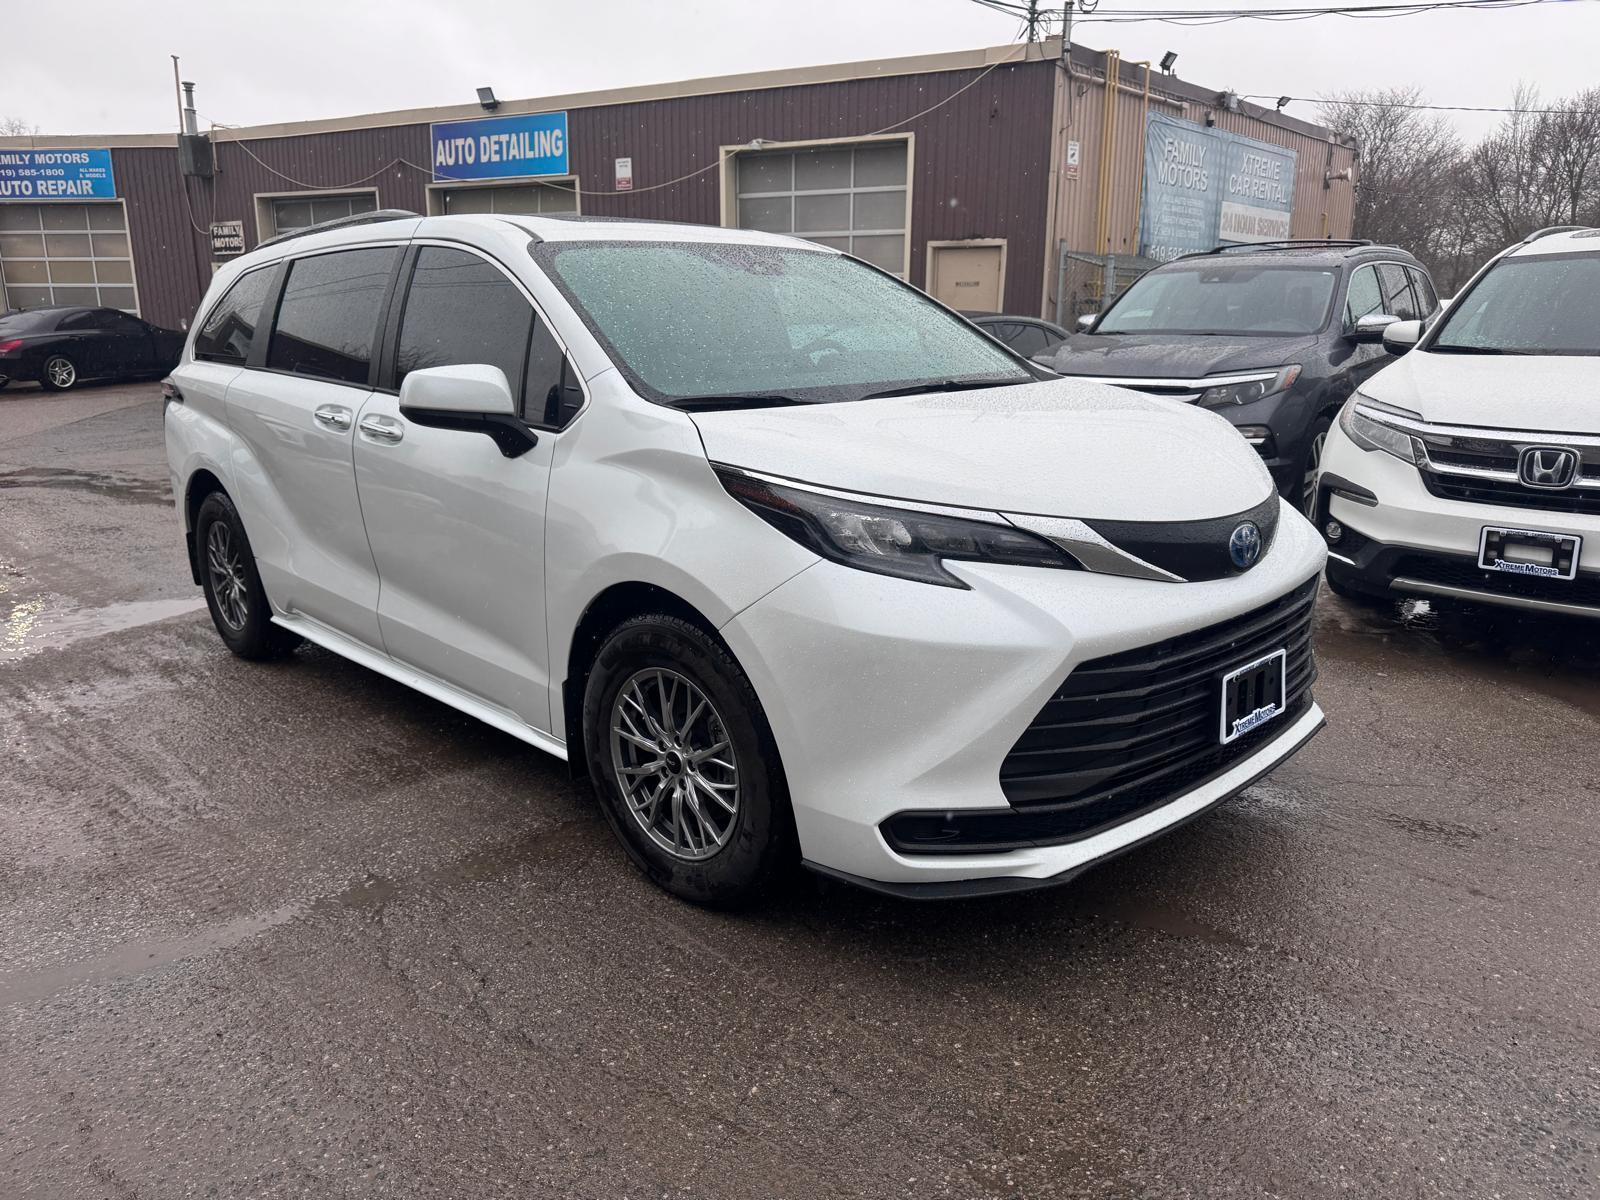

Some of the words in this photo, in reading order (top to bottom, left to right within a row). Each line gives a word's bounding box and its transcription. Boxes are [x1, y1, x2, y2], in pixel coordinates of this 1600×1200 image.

[436, 137, 475, 166] AUTO
[480, 129, 563, 163] DETAILING
[1164, 138, 1206, 168] FAMILY
[0, 153, 30, 165] MILY
[34, 153, 90, 164] MOTORS
[1241, 152, 1281, 180] XTREME
[18, 168, 65, 177] 585-1800
[1158, 161, 1208, 190] MOTORS
[0, 180, 32, 195] UTO
[37, 180, 94, 195] REPAIR
[1229, 174, 1250, 197] CAR
[1251, 179, 1287, 204] RENTAL
[213, 226, 240, 236] FAMILY
[1256, 217, 1289, 239] SERVICE
[214, 237, 243, 248] MOTORS
[1525, 564, 1558, 576] MOTORS
